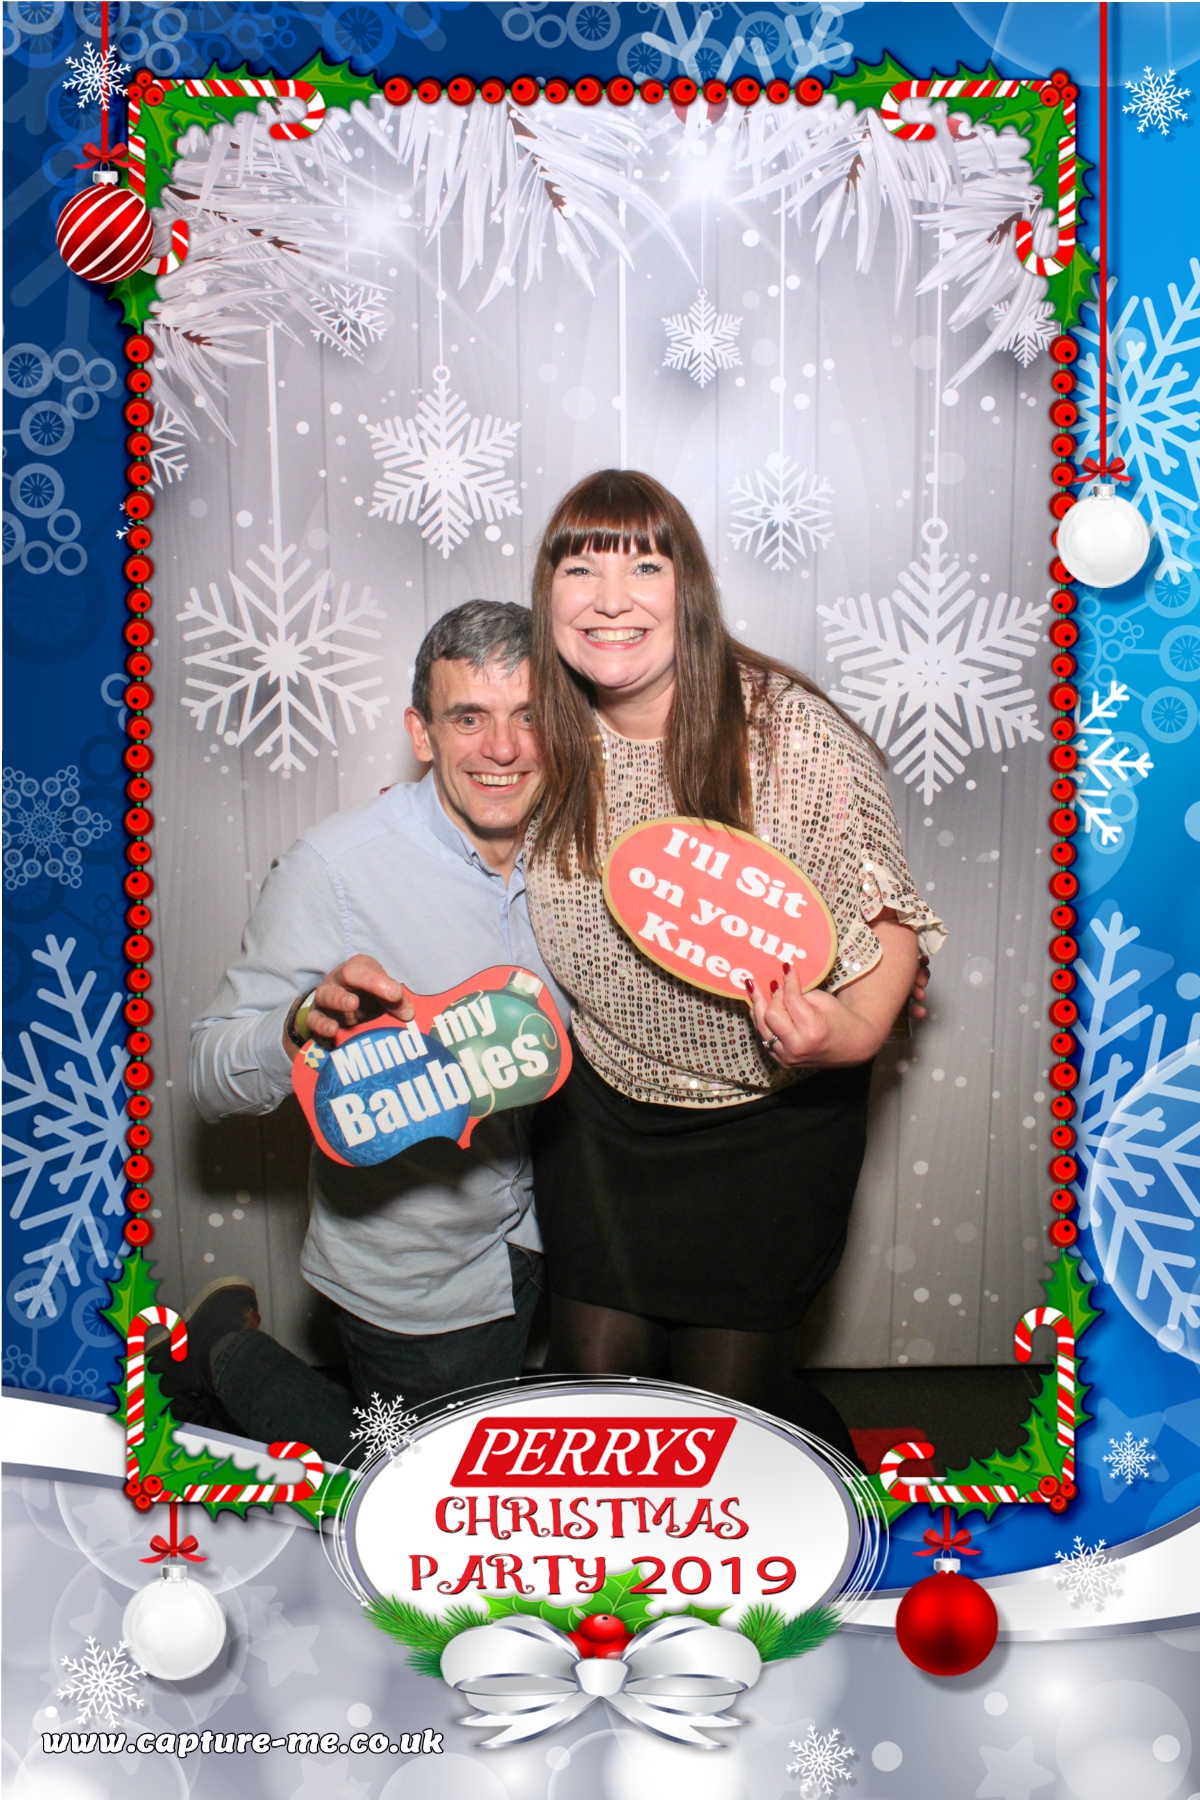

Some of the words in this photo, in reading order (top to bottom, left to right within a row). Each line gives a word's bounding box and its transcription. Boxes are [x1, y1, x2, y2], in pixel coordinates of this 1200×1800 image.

[628, 867, 686, 908] on
[690, 898, 807, 965] your
[663, 827, 730, 880] I'll
[736, 866, 808, 918] Sit
[638, 912, 754, 990] Knee
[329, 1020, 428, 1086] Mind
[432, 996, 497, 1047] my
[329, 1033, 549, 1148] Baubles
